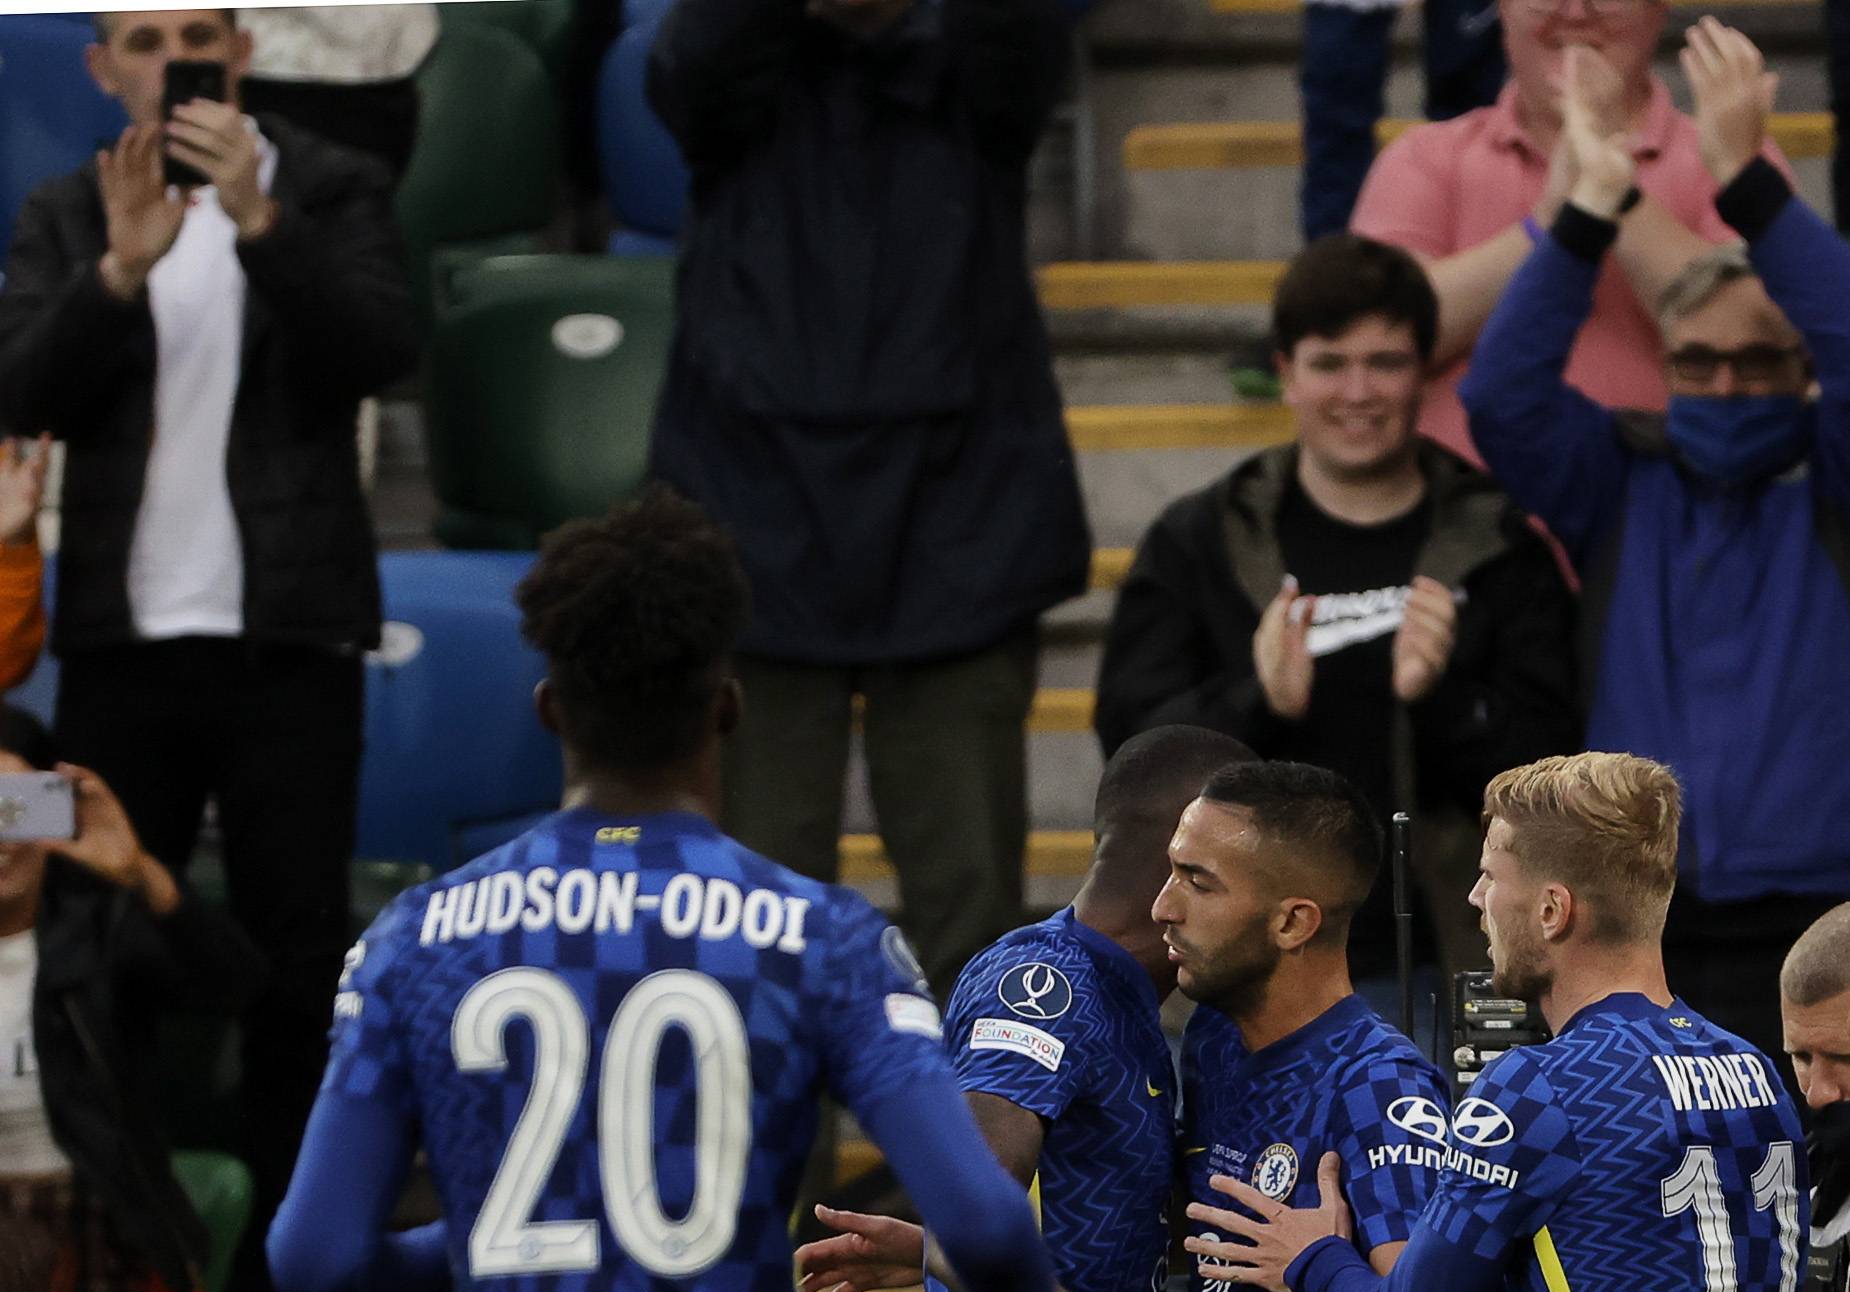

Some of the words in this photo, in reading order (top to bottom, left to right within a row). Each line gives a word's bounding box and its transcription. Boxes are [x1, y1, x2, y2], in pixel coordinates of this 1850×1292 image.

[420, 866, 808, 954] HUDSON-ODOI
[975, 1028, 1060, 1060] FOUNDATION
[1652, 1054, 1777, 1111] WERNER
[450, 965, 753, 1279] 20
[1368, 1144, 1446, 1170] HYUN
[1446, 1145, 1518, 1189] UNDAI
